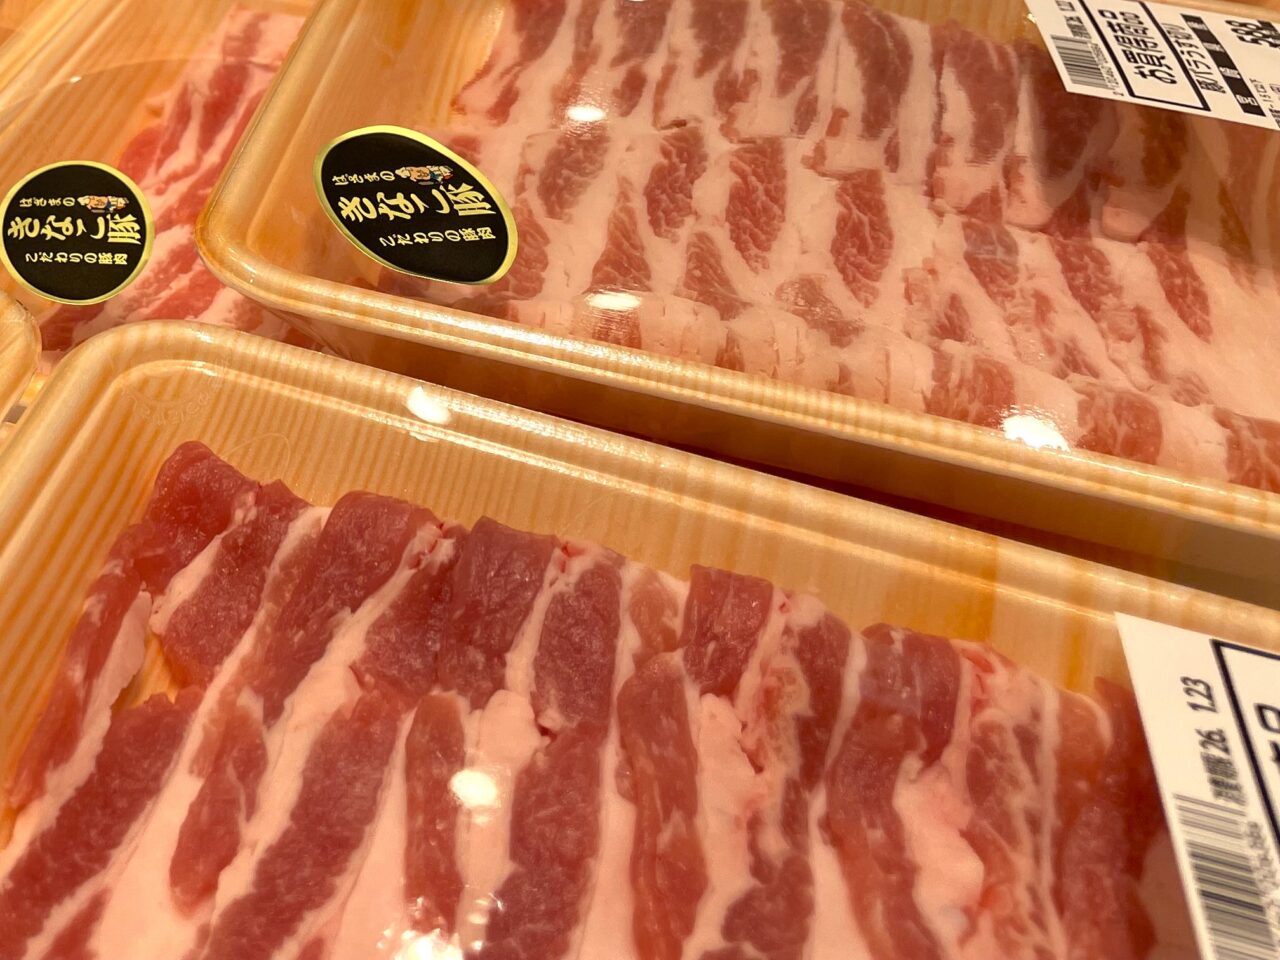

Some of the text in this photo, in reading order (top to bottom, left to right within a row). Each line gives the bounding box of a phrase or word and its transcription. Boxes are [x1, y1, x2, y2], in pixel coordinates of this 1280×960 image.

[1099, 10, 1177, 85] お買得商品
[338, 182, 497, 223] きなこ豚
[7, 213, 142, 245] きなこ豚
[379, 226, 497, 248] こだわりの豚肉
[25, 251, 128, 265] こだわりの豚肉
